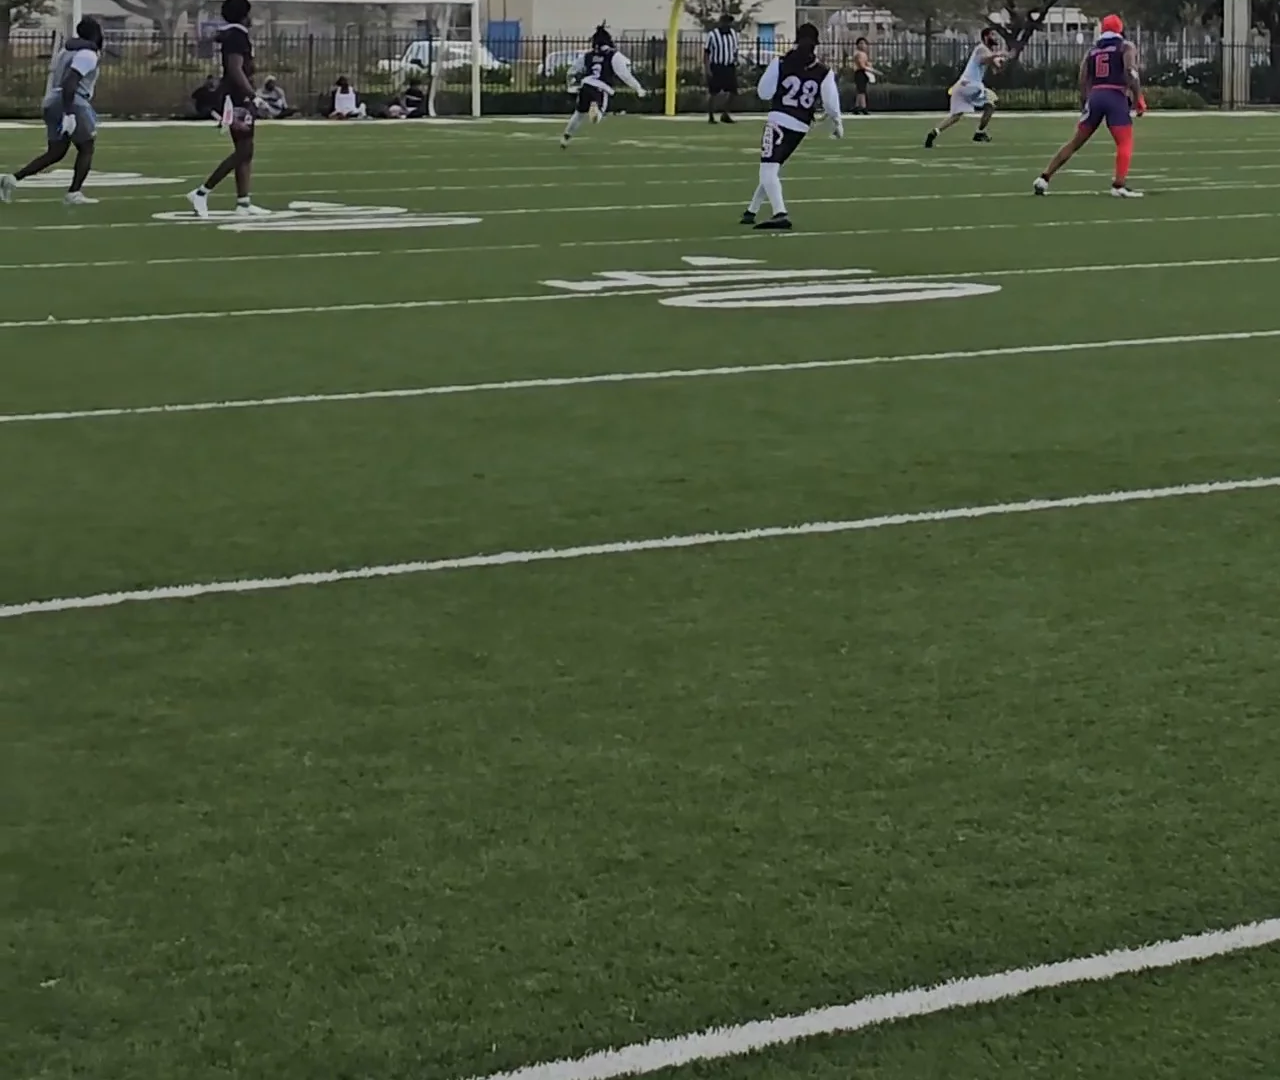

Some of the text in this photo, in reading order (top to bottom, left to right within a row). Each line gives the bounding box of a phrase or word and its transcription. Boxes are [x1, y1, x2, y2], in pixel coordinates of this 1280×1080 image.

[1095, 52, 1110, 78] 6
[781, 75, 819, 109] 28
[537, 269, 1003, 308] 40
